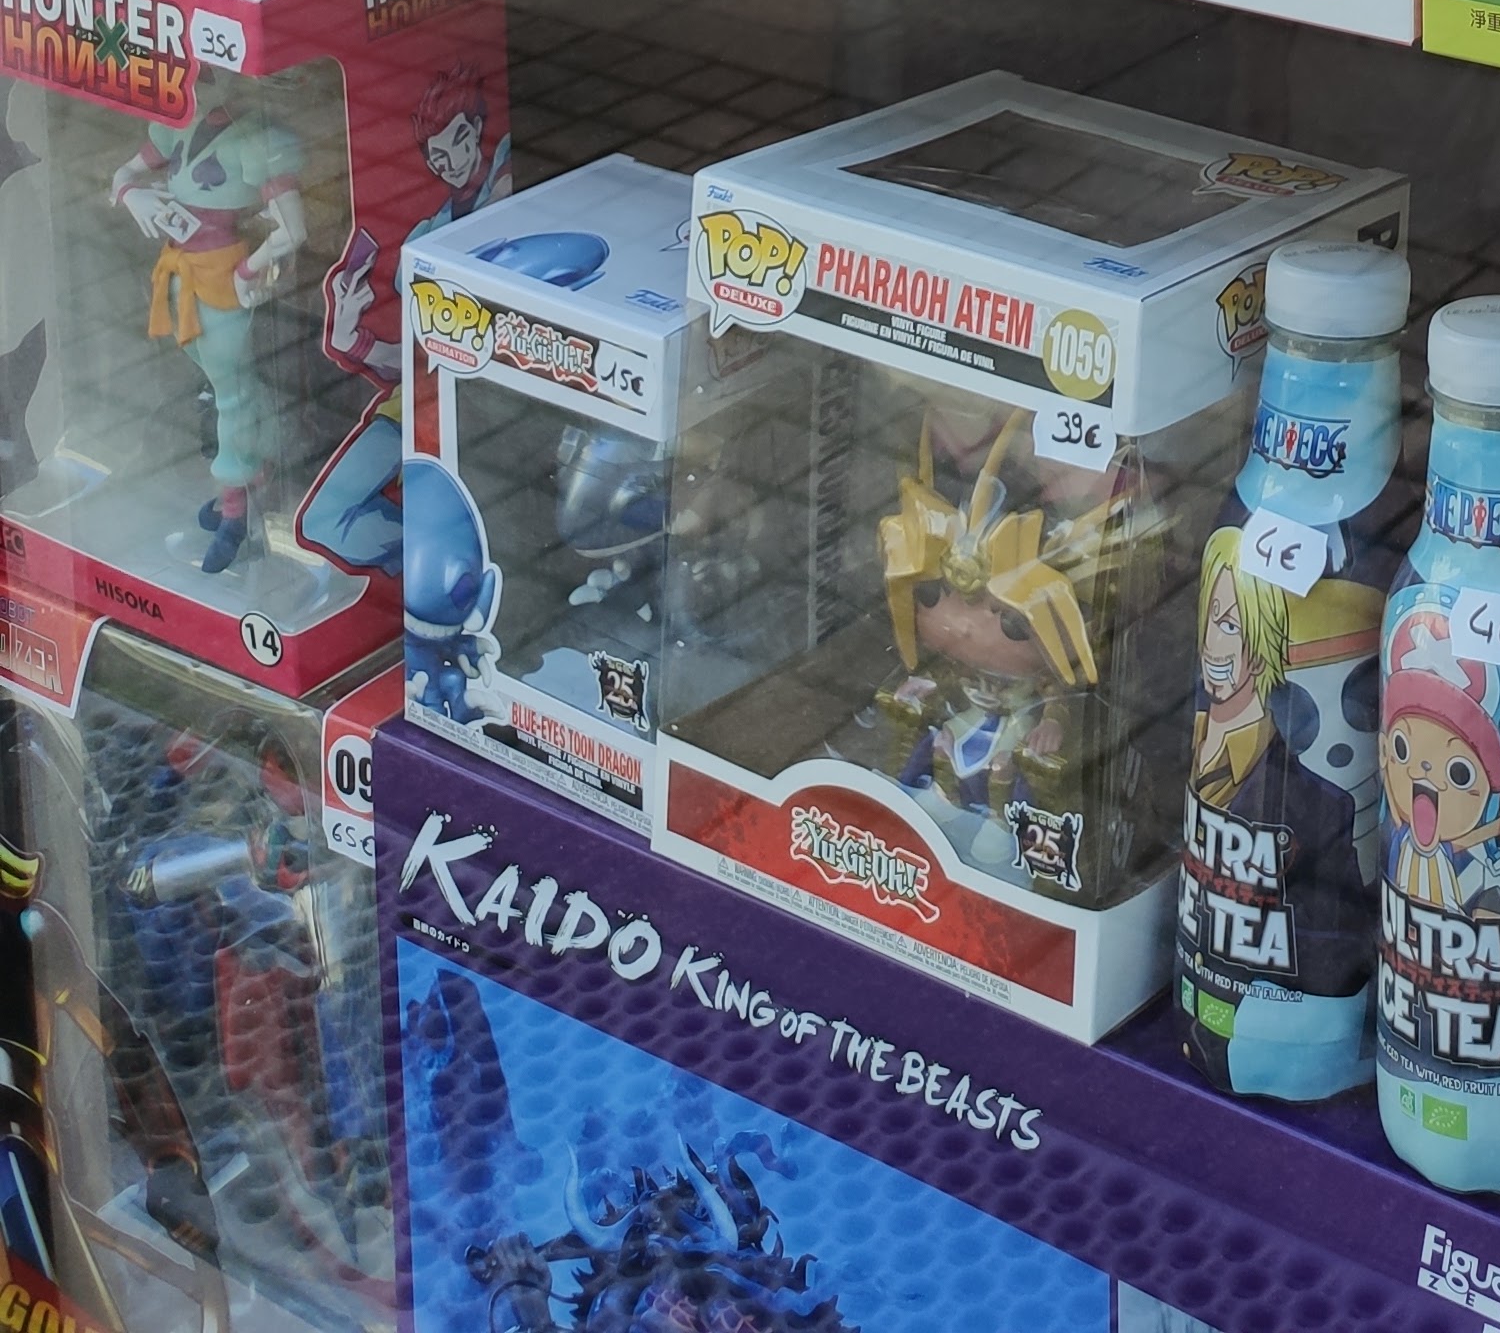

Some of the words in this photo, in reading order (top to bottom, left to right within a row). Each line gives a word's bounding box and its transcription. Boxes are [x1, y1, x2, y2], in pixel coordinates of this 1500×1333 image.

[699, 209, 808, 296] POP!
[718, 284, 778, 314] DELUXE
[816, 243, 950, 324] PHARAOH
[953, 284, 1035, 350] ATEM
[1048, 321, 1114, 385] 1059
[1255, 527, 1302, 571] 4€
[95, 576, 164, 622] HISOKA
[245, 622, 279, 658] 14
[512, 701, 566, 752] BLUE-EYES
[569, 727, 595, 763] TOON
[598, 740, 641, 785] DRAGON
[1205, 893, 1289, 969] TEA
[400, 807, 663, 979] KAIDO
[670, 946, 776, 1028] KING
[780, 1006, 826, 1044] OF
[829, 1019, 895, 1084] THE
[896, 1051, 1042, 1151] BEASTS
[1416, 1065, 1439, 1086] WITH
[1442, 1075, 1461, 1091] RED
[1463, 1081, 1495, 1095] FRUIT
